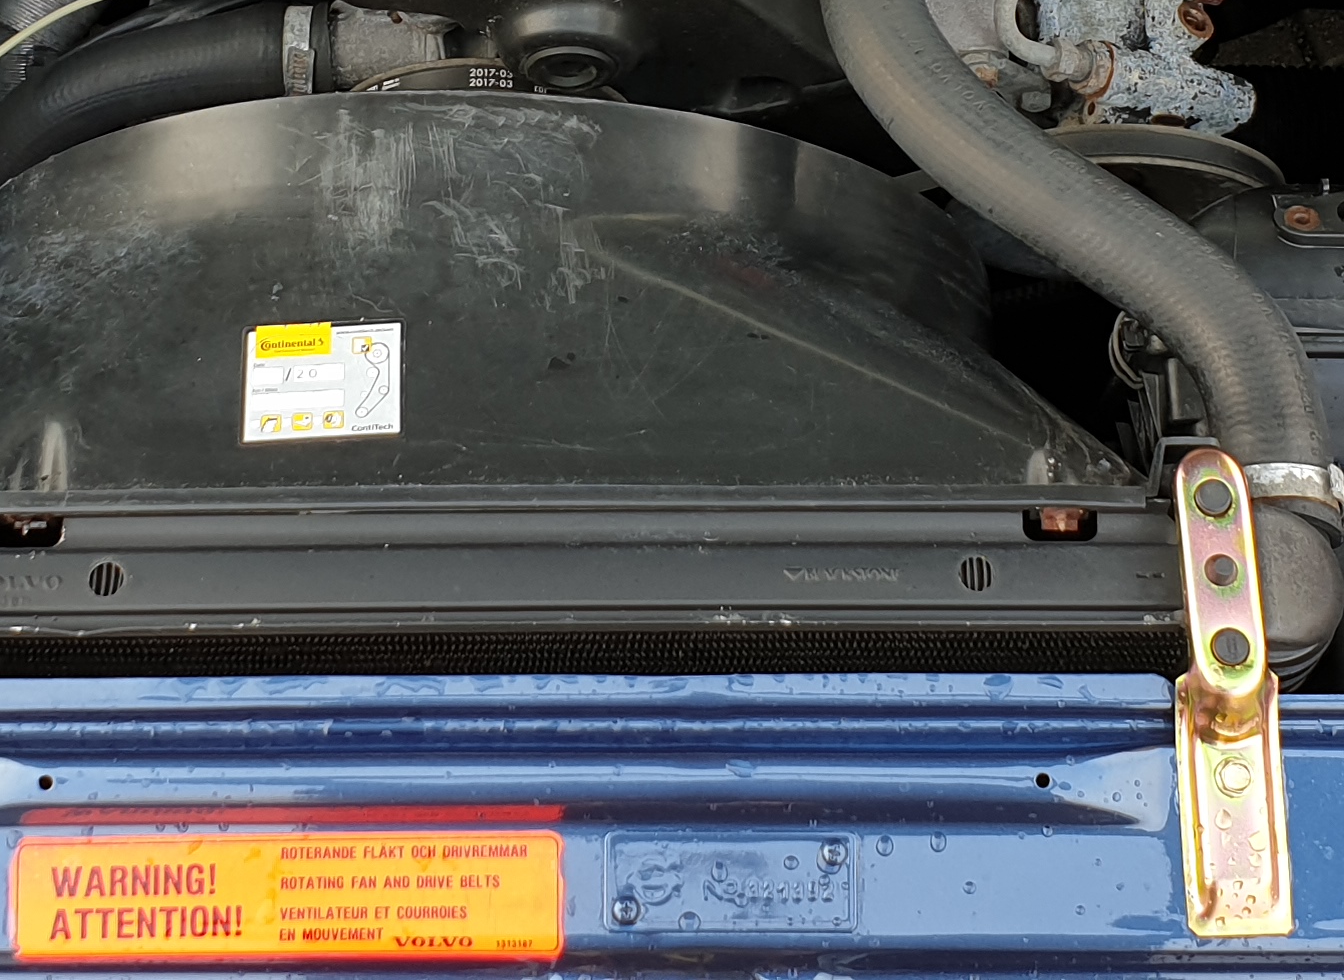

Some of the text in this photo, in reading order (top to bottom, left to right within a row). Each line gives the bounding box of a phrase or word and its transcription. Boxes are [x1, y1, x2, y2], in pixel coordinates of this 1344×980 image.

[260, 338, 316, 352] Continental
[351, 423, 394, 432] ContiTech
[280, 844, 528, 861] ROTERANDE FLÄKT OCH DRIVREMMAR
[51, 863, 217, 898] WARNING!
[280, 874, 500, 889] ROTATING FAN AND DRIVE BELTS
[280, 906, 468, 920] VENTILATEUR ET COURROIES
[49, 905, 243, 941] ATTENTION!
[279, 927, 384, 941] EN MOUVEMENT
[393, 936, 473, 947] VOLVO
